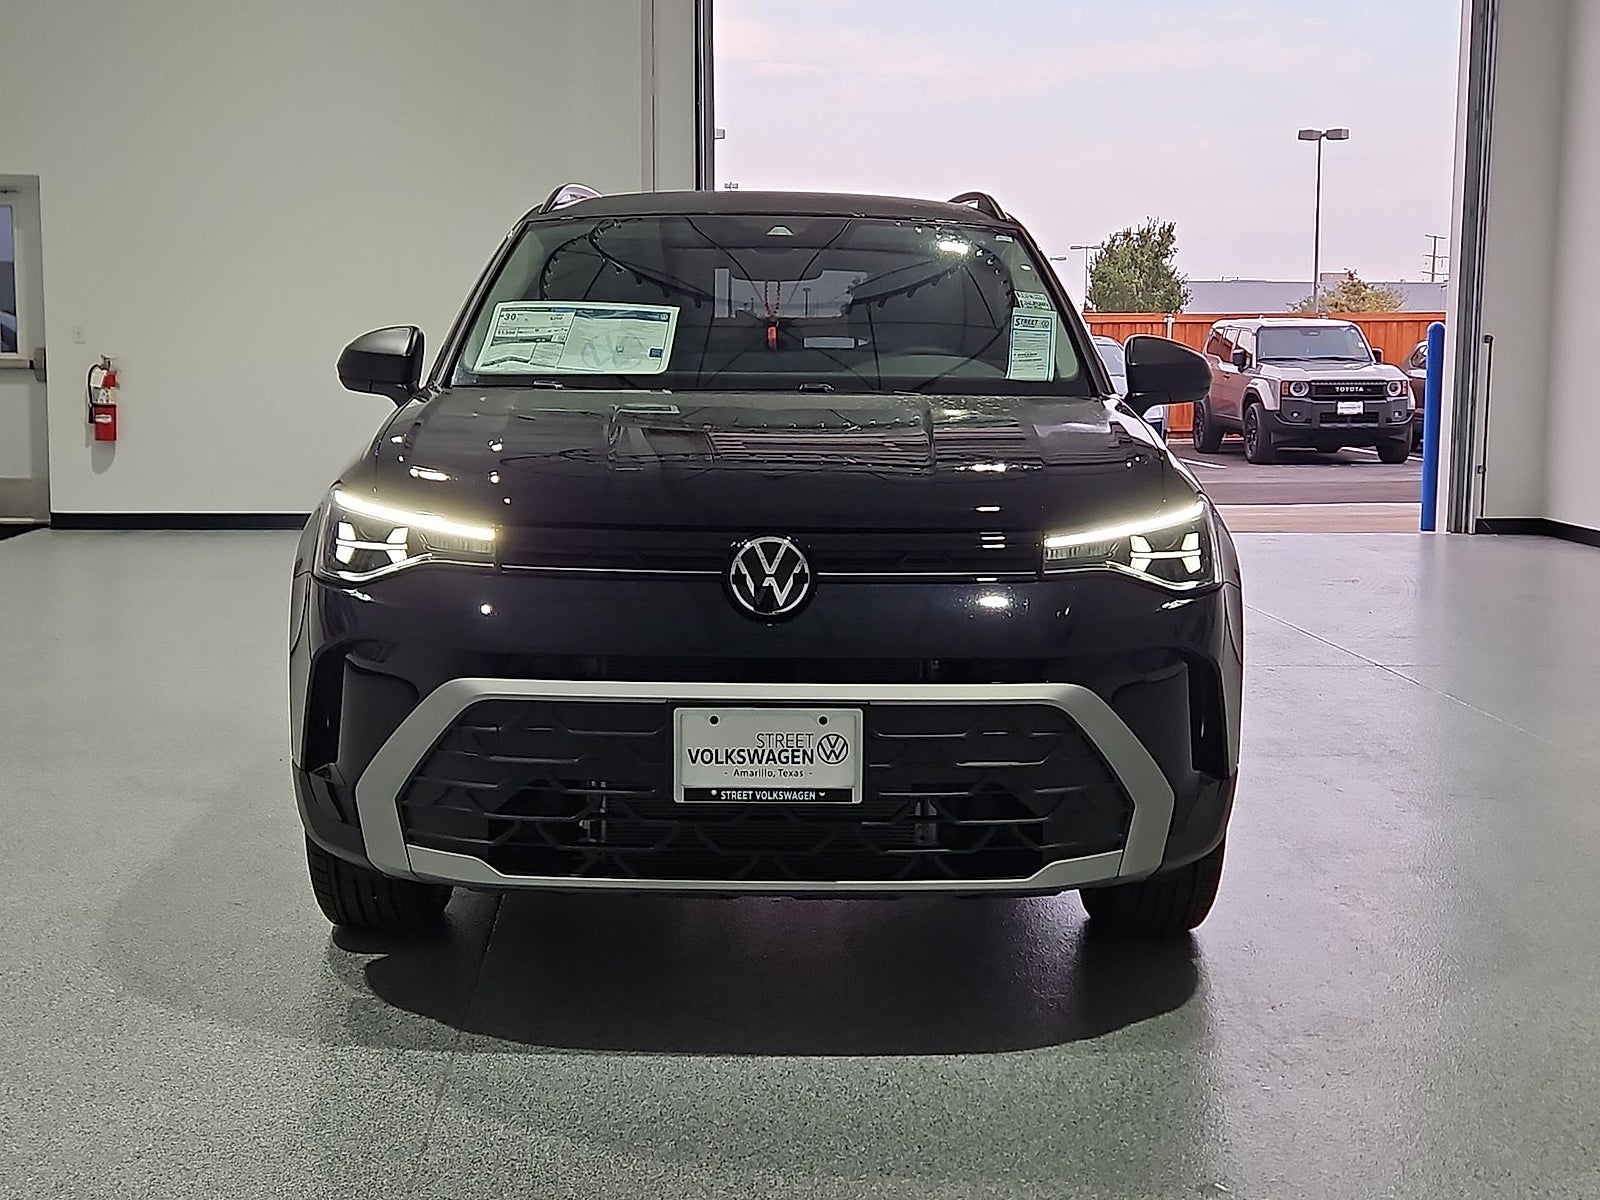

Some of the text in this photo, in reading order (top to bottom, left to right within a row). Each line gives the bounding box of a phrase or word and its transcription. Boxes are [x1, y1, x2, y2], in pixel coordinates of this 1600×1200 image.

[756, 733, 814, 749] STREET
[687, 748, 815, 765] VOLKSWAGEN
[733, 768, 804, 779] Amarillo, Texas
[720, 790, 816, 800] STREET VOLKSWAGEN
